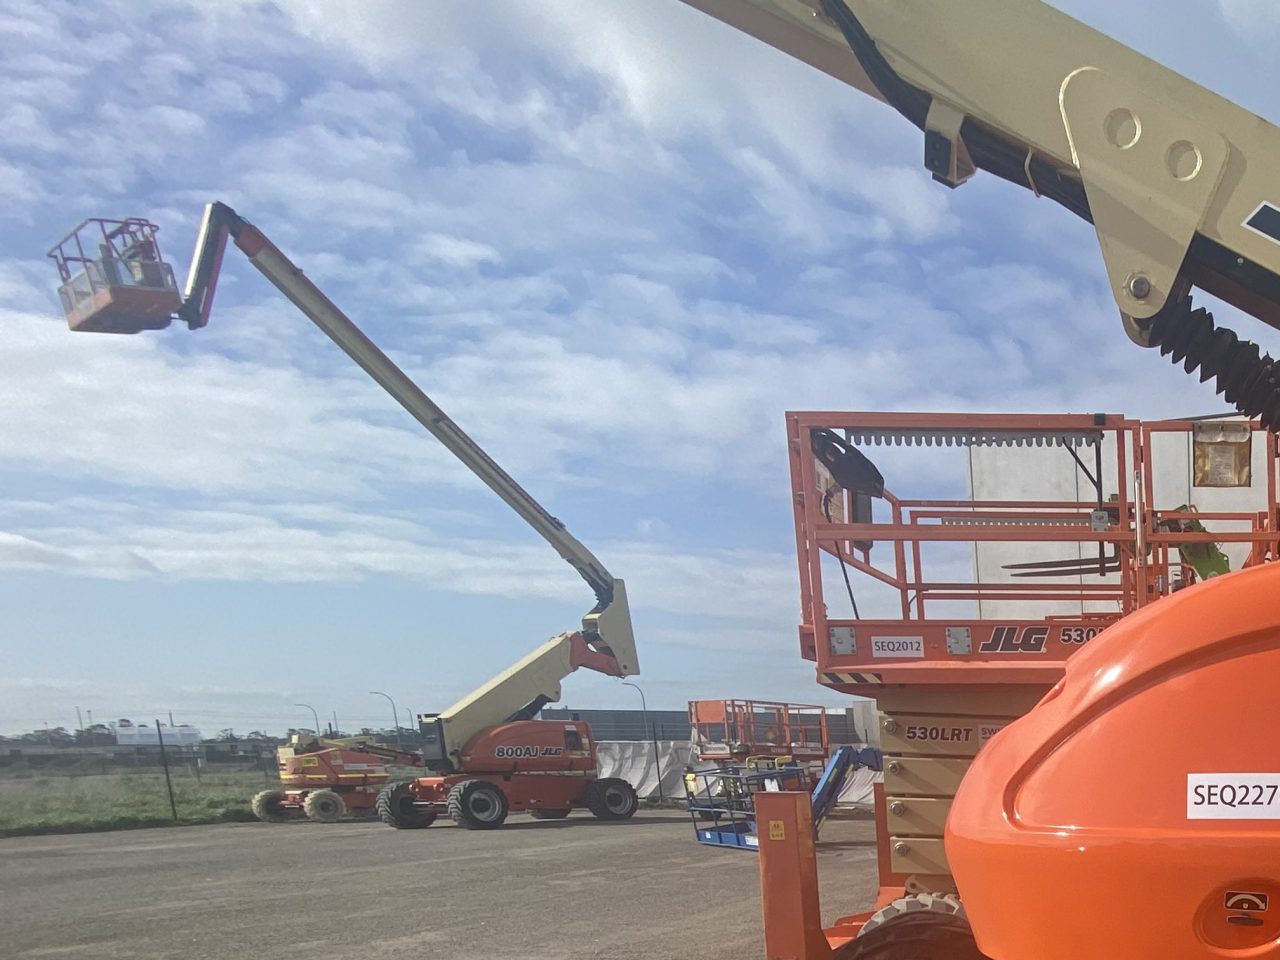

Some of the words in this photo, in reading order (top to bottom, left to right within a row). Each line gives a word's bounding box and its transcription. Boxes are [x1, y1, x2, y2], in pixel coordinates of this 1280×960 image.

[873, 640, 922, 652] SEQ2012
[979, 626, 1050, 653] JLG
[905, 726, 973, 742] 530LRT
[496, 746, 540, 758] 800AJ
[540, 747, 564, 757] JLG
